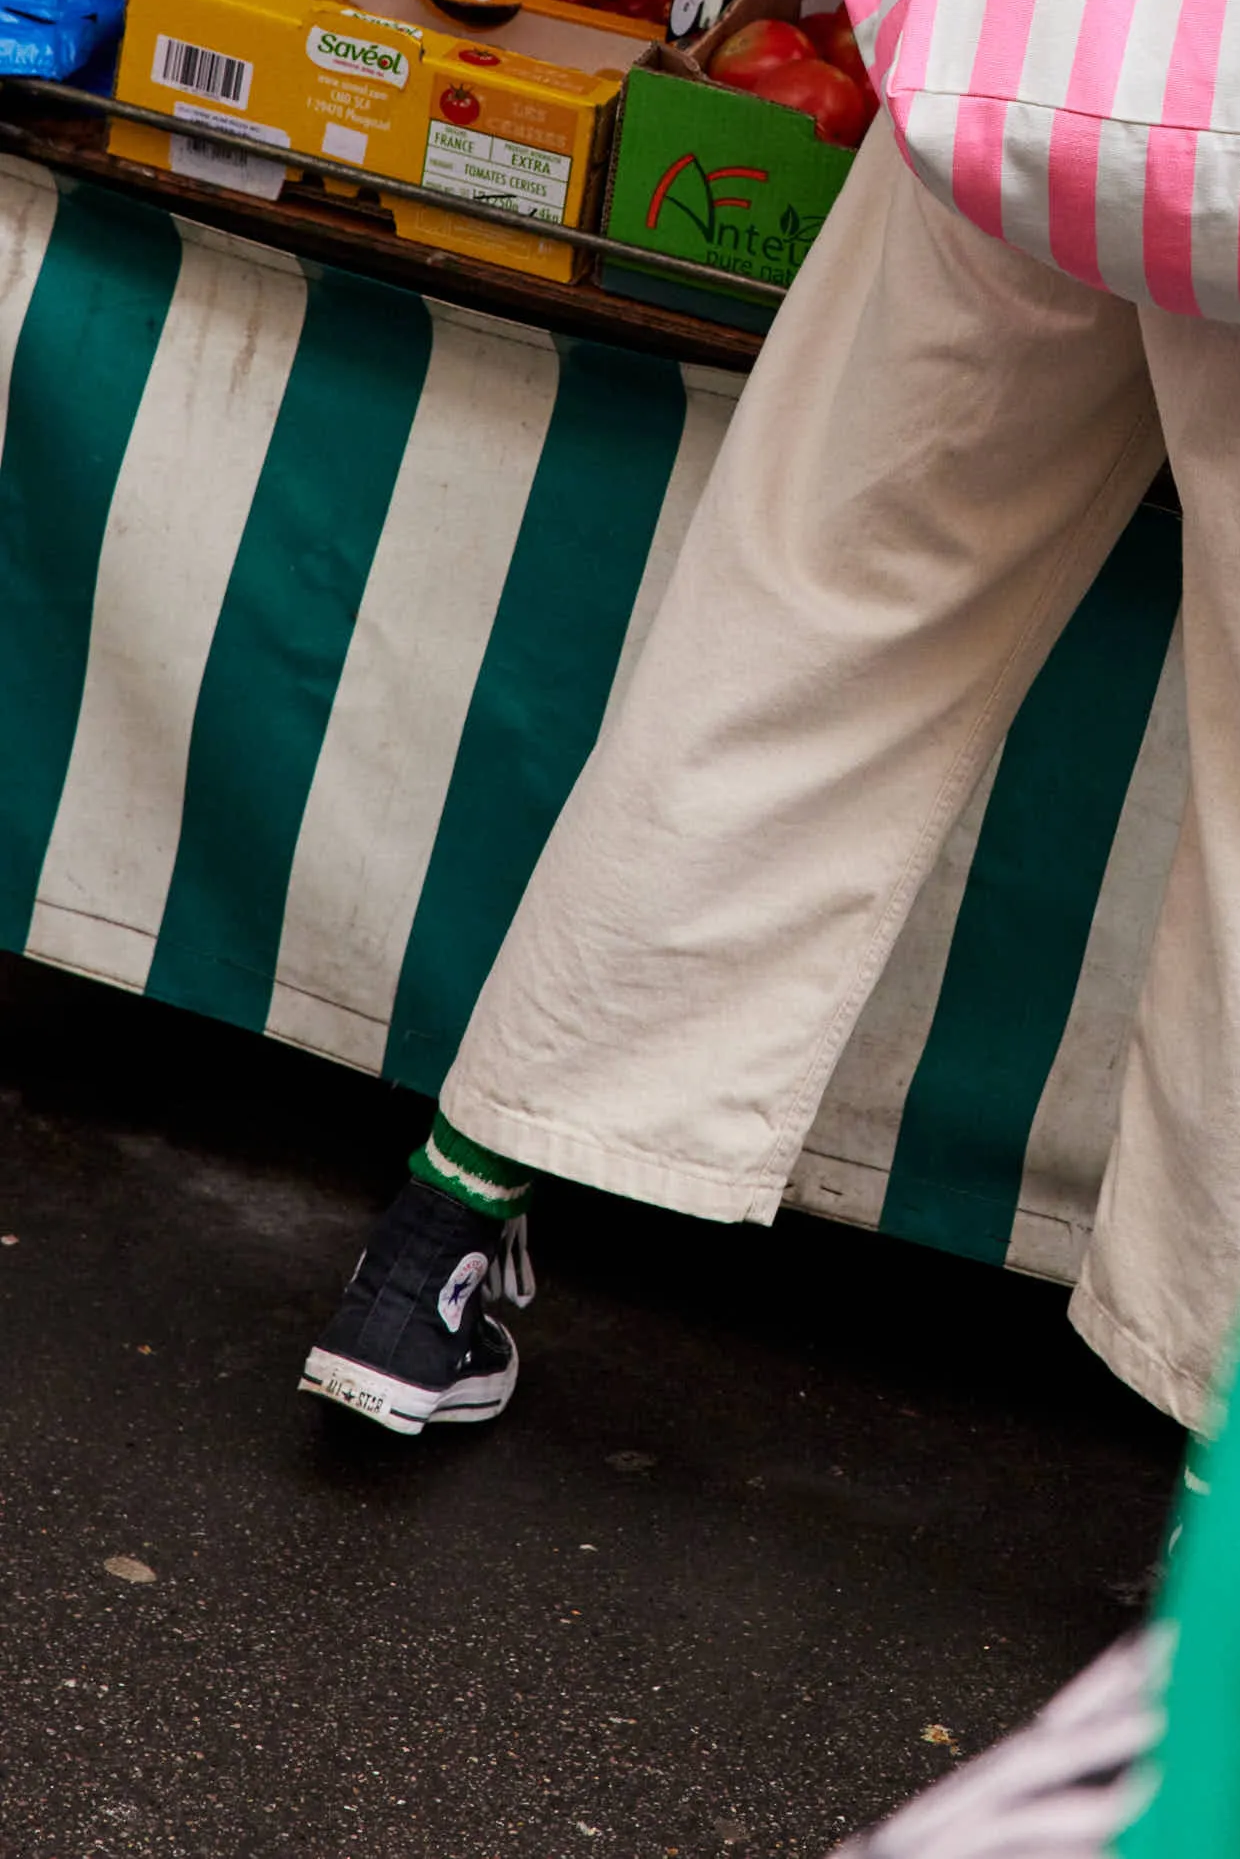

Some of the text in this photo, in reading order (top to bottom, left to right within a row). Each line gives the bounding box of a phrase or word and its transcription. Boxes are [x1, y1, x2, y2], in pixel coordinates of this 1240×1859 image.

[317, 32, 402, 75] Savéol
[433, 133, 474, 154] FRANCE
[510, 154, 551, 176] EXTRA
[464, 163, 548, 198] TOMATES CERISES
[706, 250, 753, 276] pure
